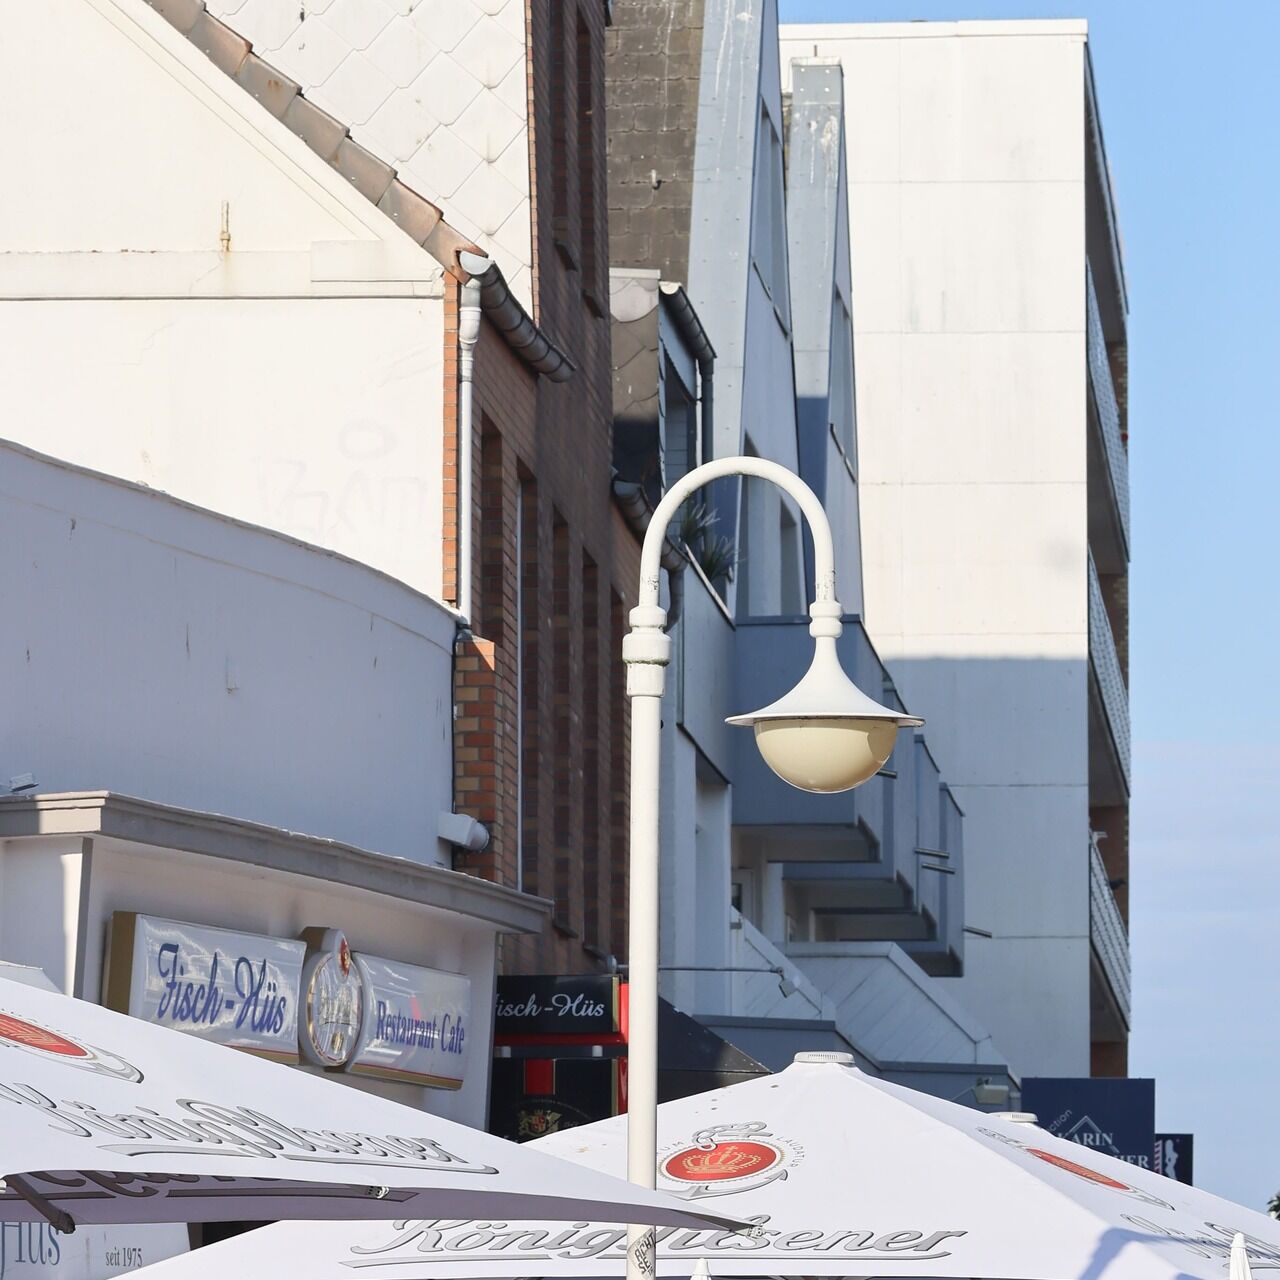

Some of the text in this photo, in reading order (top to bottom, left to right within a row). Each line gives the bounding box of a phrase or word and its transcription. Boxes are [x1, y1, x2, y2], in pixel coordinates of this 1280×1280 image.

[158, 943, 288, 1035] Fisch-Hüs
[496, 993, 605, 1017] isch-Hüs
[106, 1246, 121, 1267] seit
[122, 1247, 143, 1268] 1975
